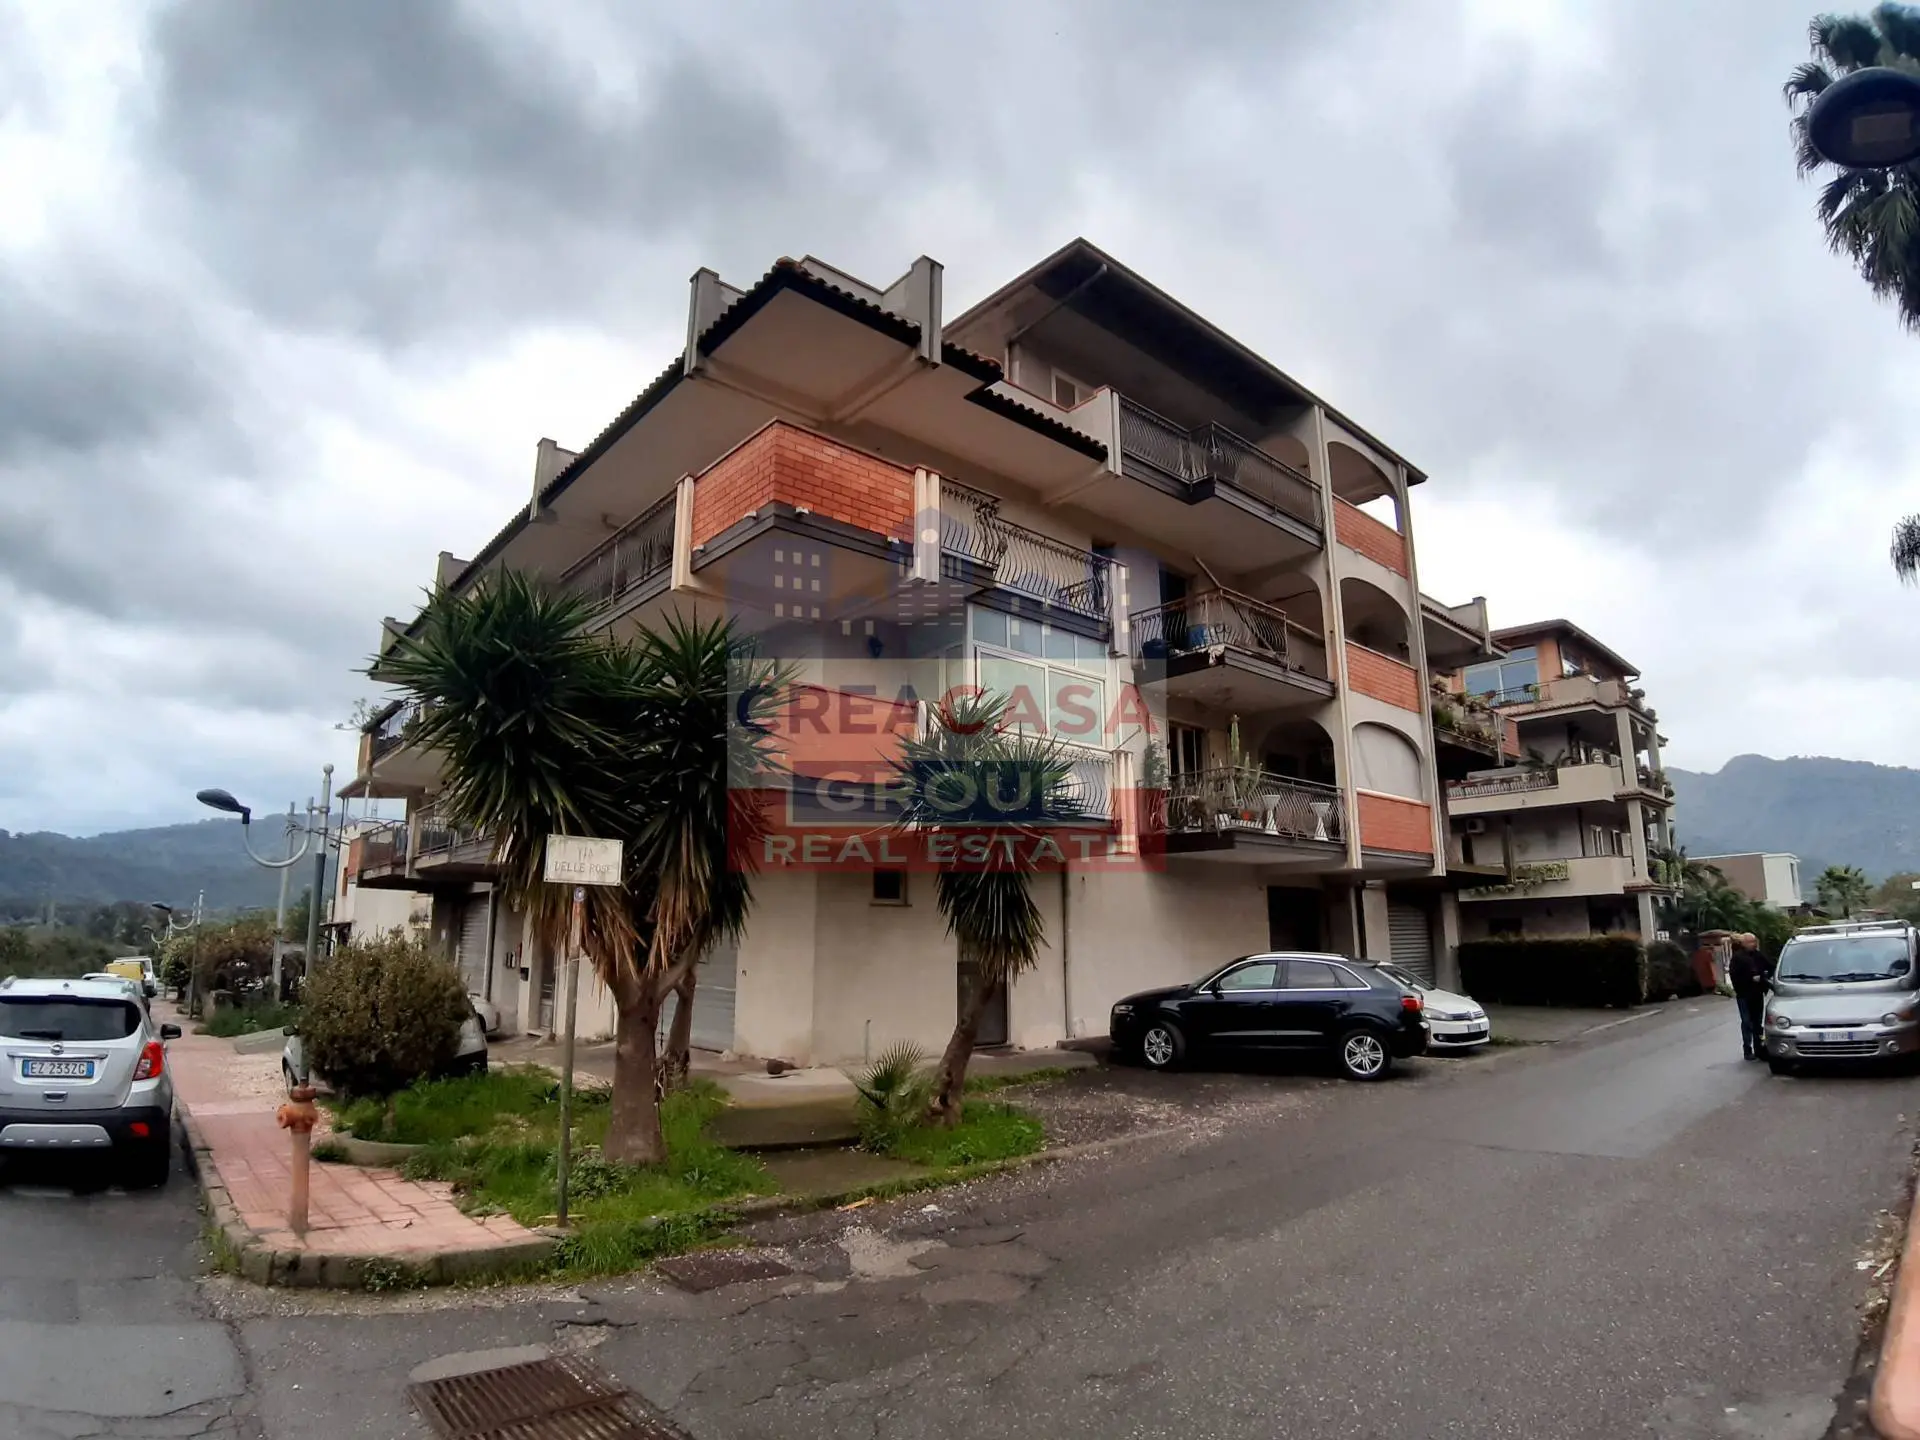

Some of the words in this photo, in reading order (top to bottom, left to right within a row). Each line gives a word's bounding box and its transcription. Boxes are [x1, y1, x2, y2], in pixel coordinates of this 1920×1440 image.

[554, 861, 585, 873] DELLE
[589, 863, 613, 873] ROSE
[31, 1062, 45, 1074] EZ
[49, 1062, 85, 1075] 233ZG
